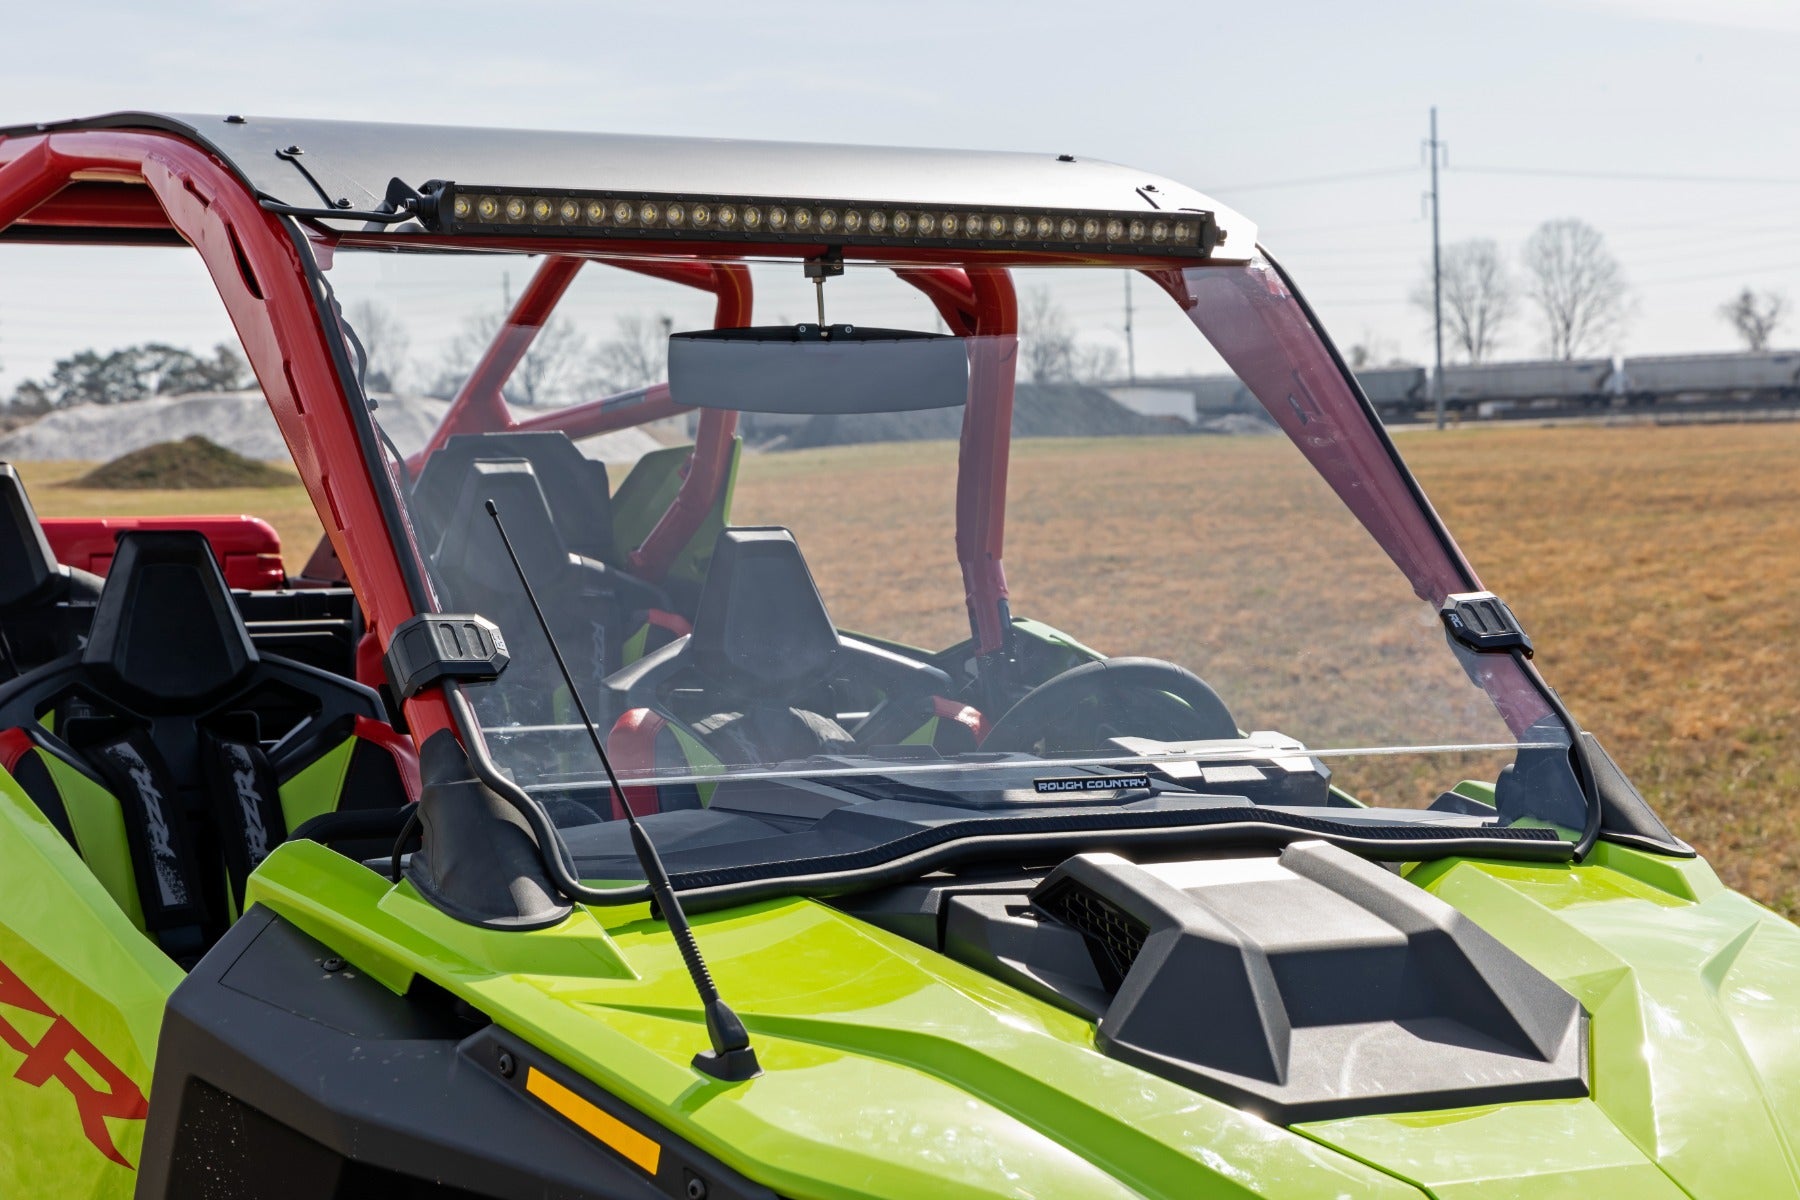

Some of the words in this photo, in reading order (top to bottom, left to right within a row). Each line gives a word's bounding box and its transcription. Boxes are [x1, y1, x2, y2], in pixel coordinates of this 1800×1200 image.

[1038, 780, 1083, 792] ROUGH
[1086, 778, 1147, 789] COUNTRY
[129, 767, 176, 858] RZR
